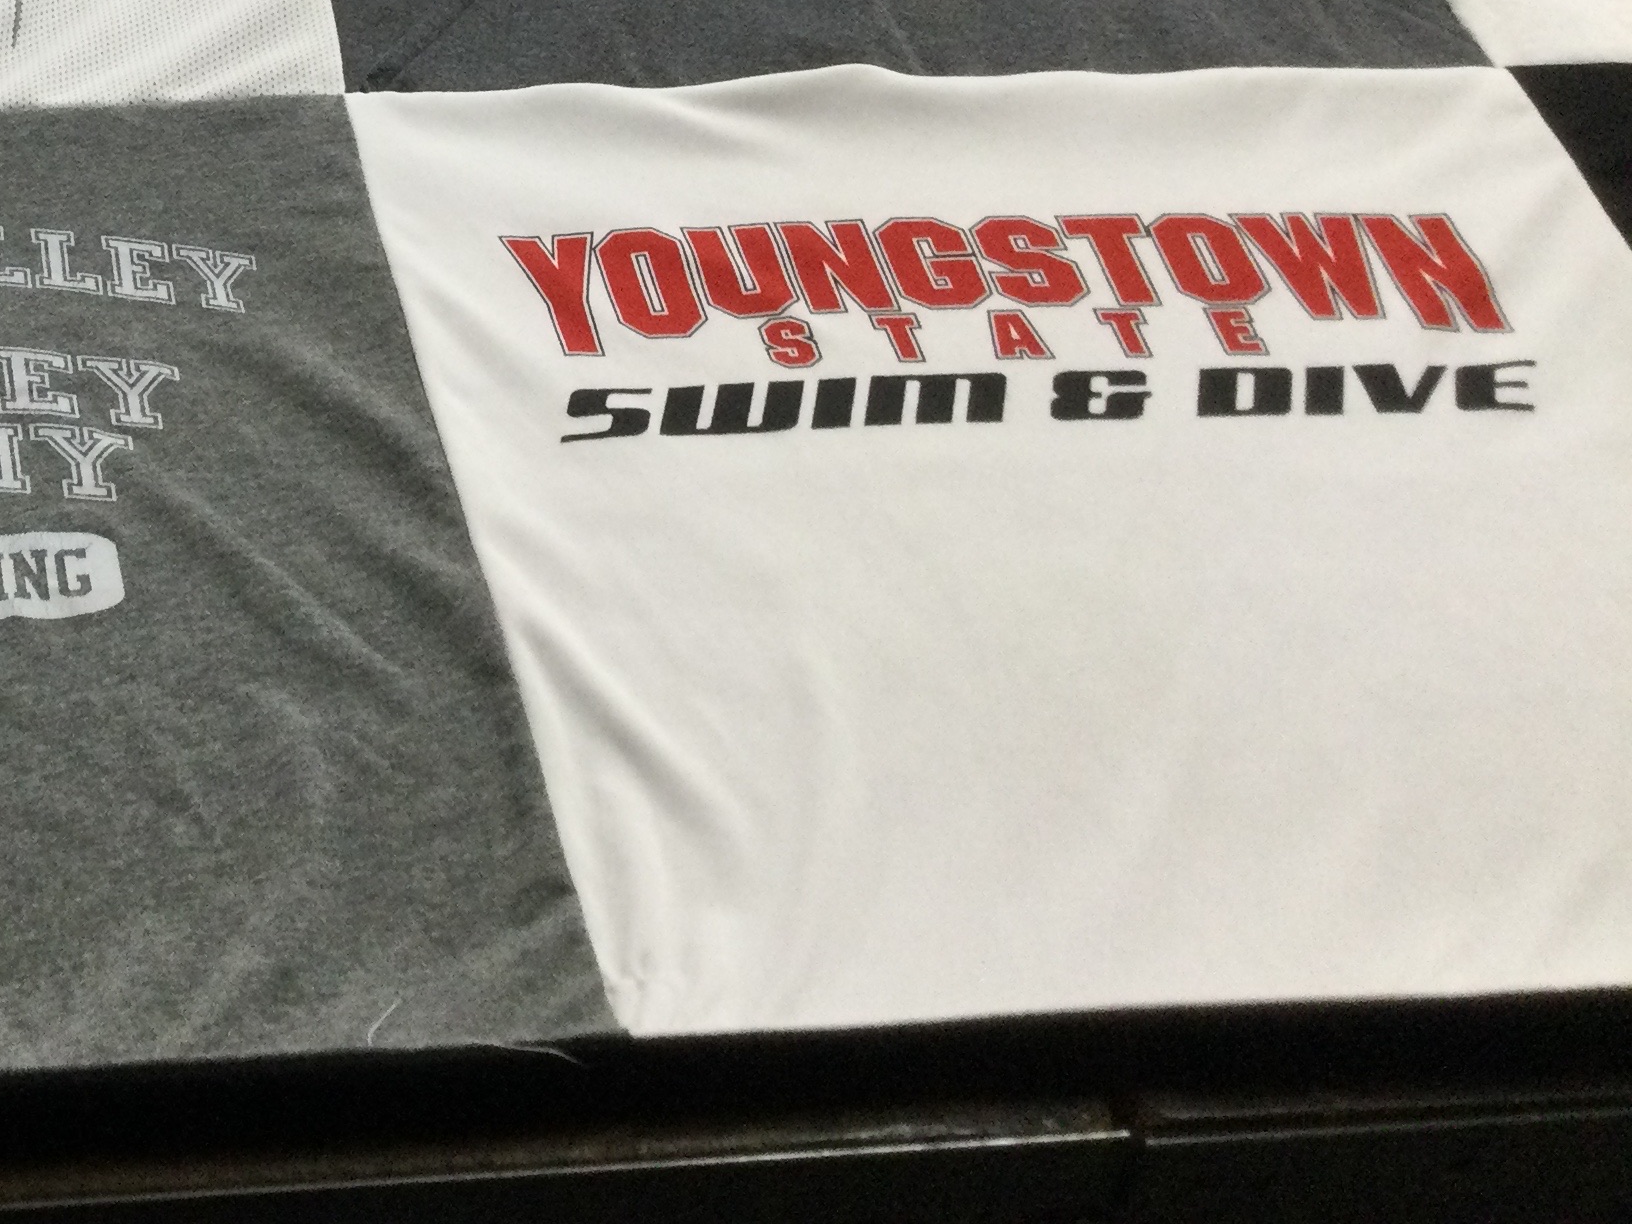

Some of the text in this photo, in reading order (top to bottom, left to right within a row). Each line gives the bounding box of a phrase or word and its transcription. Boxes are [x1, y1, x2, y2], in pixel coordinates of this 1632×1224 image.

[498, 211, 1514, 358] YOUNGSTOWN
[762, 305, 1275, 370] STATE
[1049, 369, 1153, 422] &
[1195, 360, 1537, 420] DIVE
